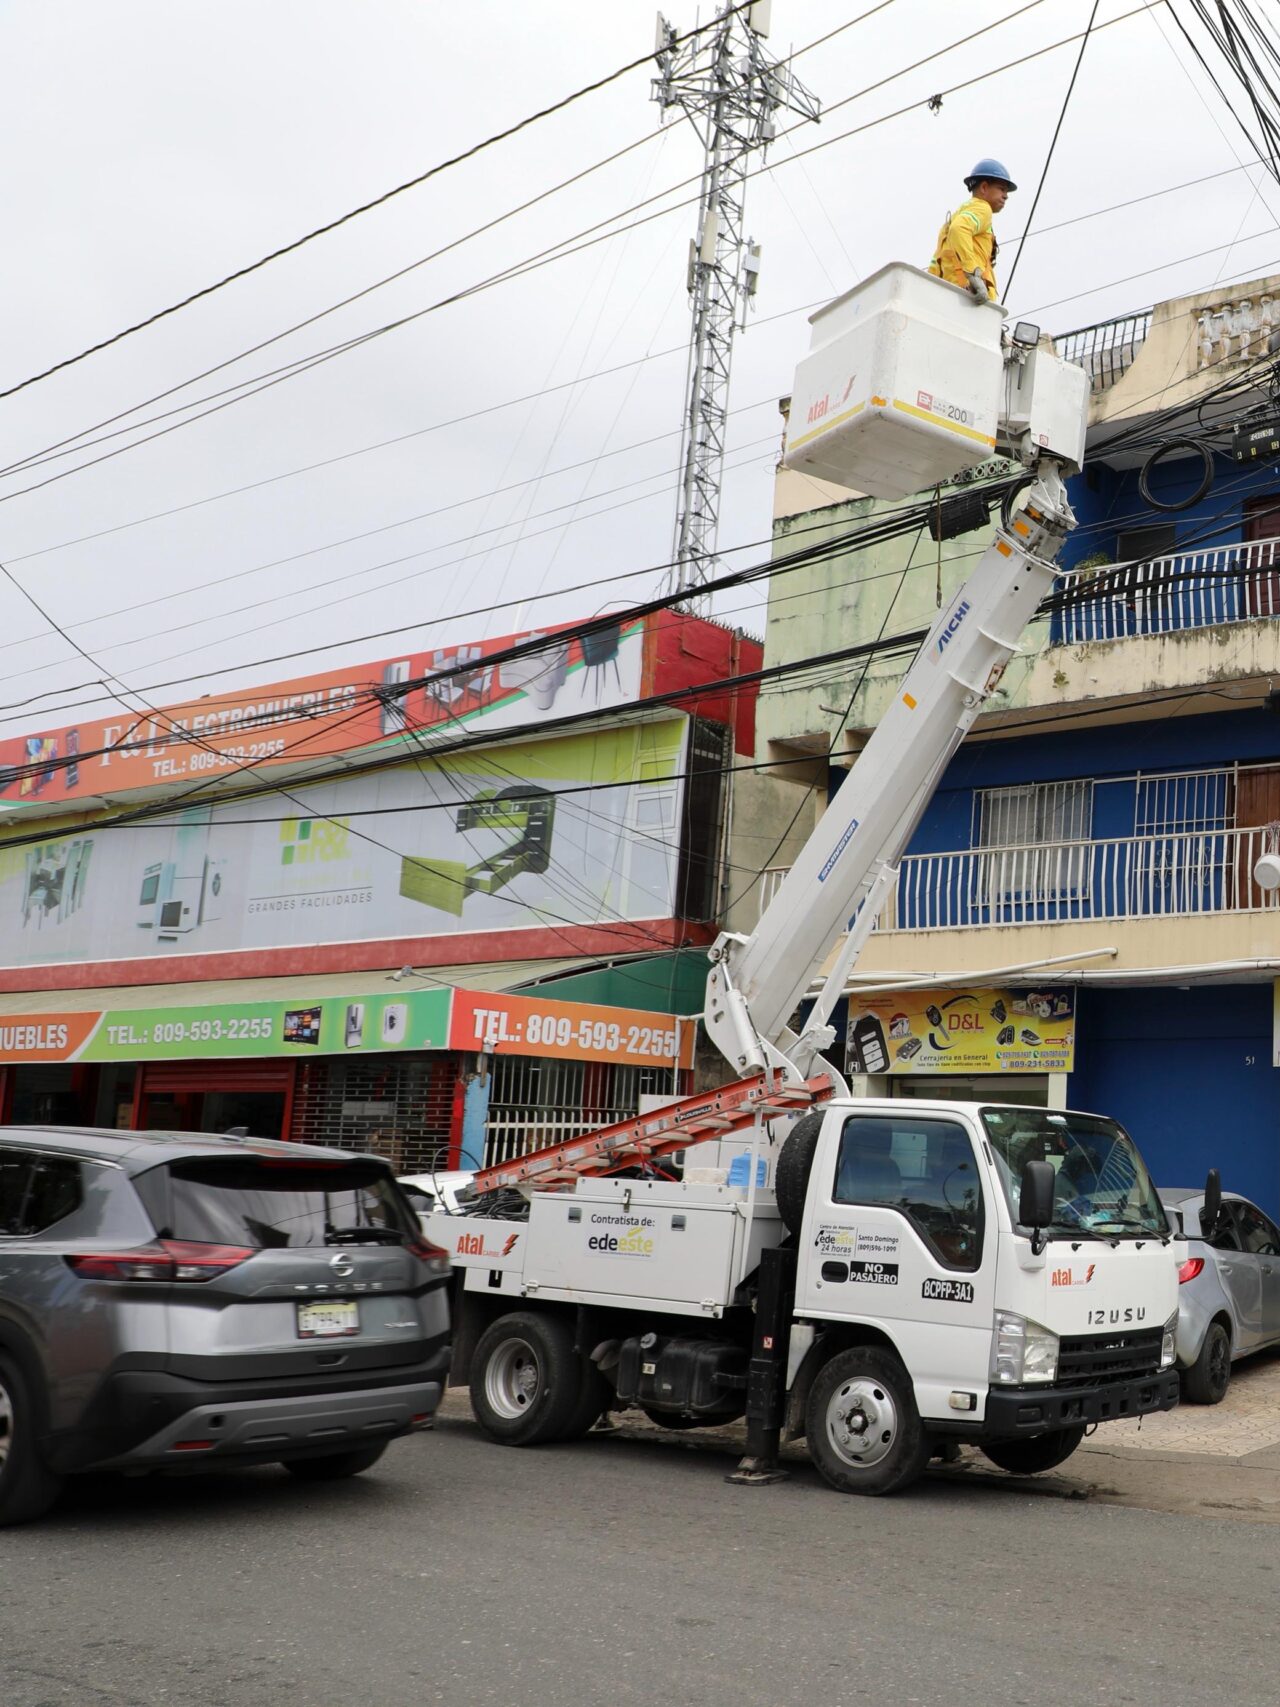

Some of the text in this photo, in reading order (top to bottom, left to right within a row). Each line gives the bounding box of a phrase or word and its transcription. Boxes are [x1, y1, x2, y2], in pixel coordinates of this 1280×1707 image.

[808, 394, 829, 424] Atal
[947, 405, 968, 423] 200
[938, 600, 970, 654] AICHI
[98, 686, 357, 767] F&L ELECTROMUEBLES
[152, 739, 285, 778] TEL.: 809-593-2255
[248, 892, 373, 914] GRANDES FACILIDADES
[948, 1013, 985, 1030] D&L
[0, 1018, 273, 1050] UEBLES TEL.: 809-593-2255
[473, 1008, 677, 1057] TEL.: 809-593-2255
[591, 1213, 656, 1227] Contratista de:
[457, 1233, 484, 1255] Atal
[588, 1233, 654, 1253] edeeste
[821, 1244, 852, 1254] 24 horas
[858, 1234, 899, 1244] Santo Domingo
[850, 1271, 897, 1284] PASAJERO
[864, 1263, 884, 1274] NO
[1051, 1268, 1072, 1286] Atal
